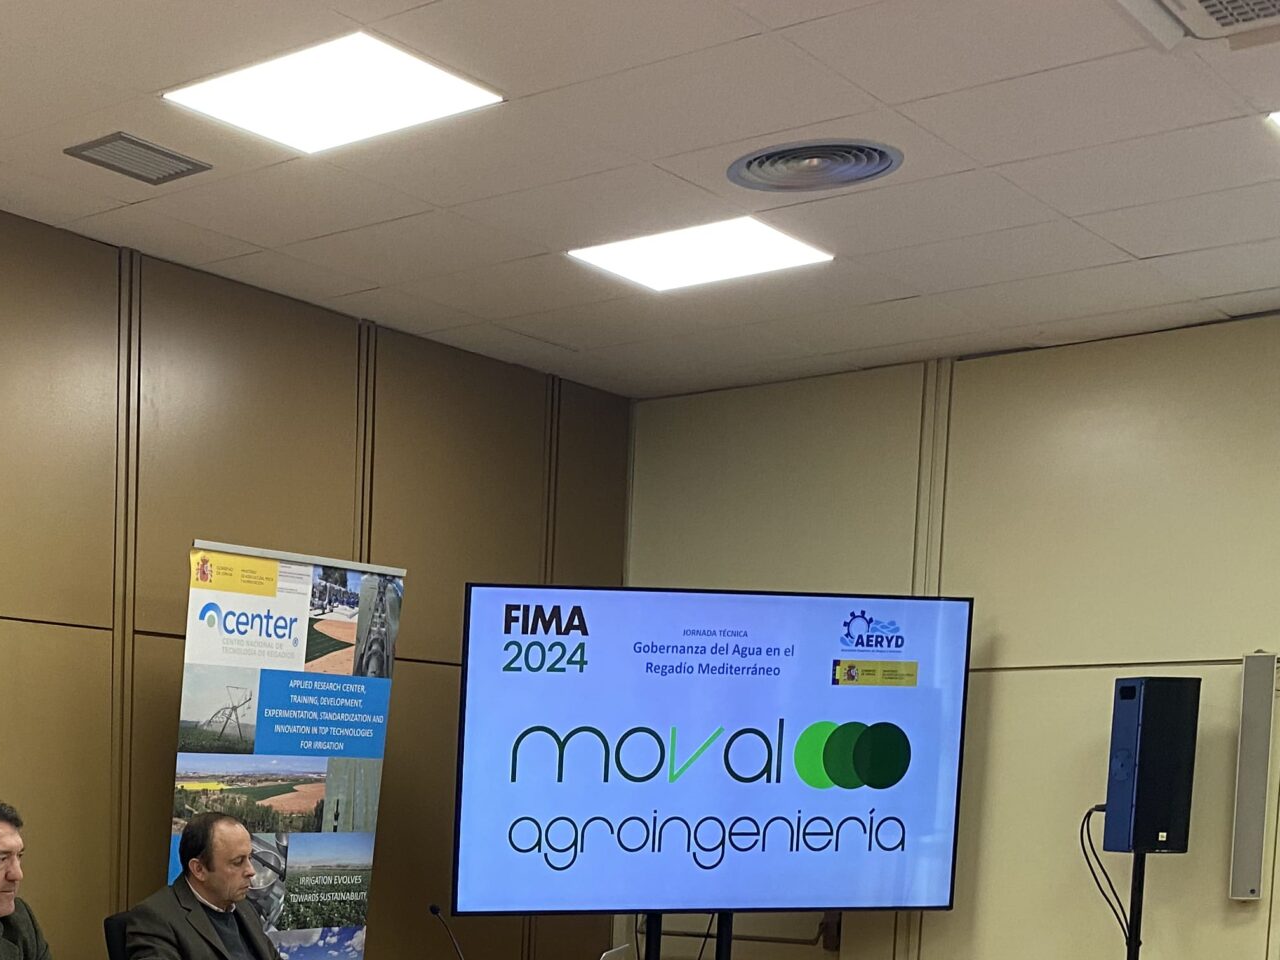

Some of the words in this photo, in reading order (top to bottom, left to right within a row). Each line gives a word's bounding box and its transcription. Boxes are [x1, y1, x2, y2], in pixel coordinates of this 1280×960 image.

[222, 609, 298, 639] center
[503, 604, 589, 636] FIMA
[683, 629, 717, 638] JORNADA
[718, 628, 748, 638] TÉCNICA
[854, 634, 904, 648] AERYD
[502, 640, 588, 673] 2024
[633, 641, 707, 656] Gobernanza
[710, 642, 728, 656] del
[732, 643, 762, 660] Agua
[766, 646, 780, 656] en
[784, 644, 794, 656] el
[645, 662, 694, 678] Regadío
[698, 662, 781, 676] Mediterráneo
[289, 679, 313, 689] APPLIED
[314, 681, 340, 692] RESEARCH
[342, 683, 366, 694] CENTER,
[290, 695, 319, 706] TRAINING,
[320, 697, 363, 708] DEVELOPMENT,
[264, 708, 318, 720] EXPERIMENTATION,
[320, 711, 370, 722] STANDARDIZATION
[372, 714, 384, 724] AND
[274, 724, 310, 734] INNOVATION
[312, 726, 318, 734] IN
[319, 726, 328, 735] TOP
[330, 727, 374, 737] TECHNOLOGIES
[300, 740, 312, 749] FOR
[313, 741, 344, 750] IRRIGATION
[510, 718, 785, 784] moval
[508, 807, 906, 871] agroingeniería
[300, 876, 332, 885] IRRIGATION
[334, 876, 362, 884] EVOLVES
[290, 893, 318, 902] TOWARDS
